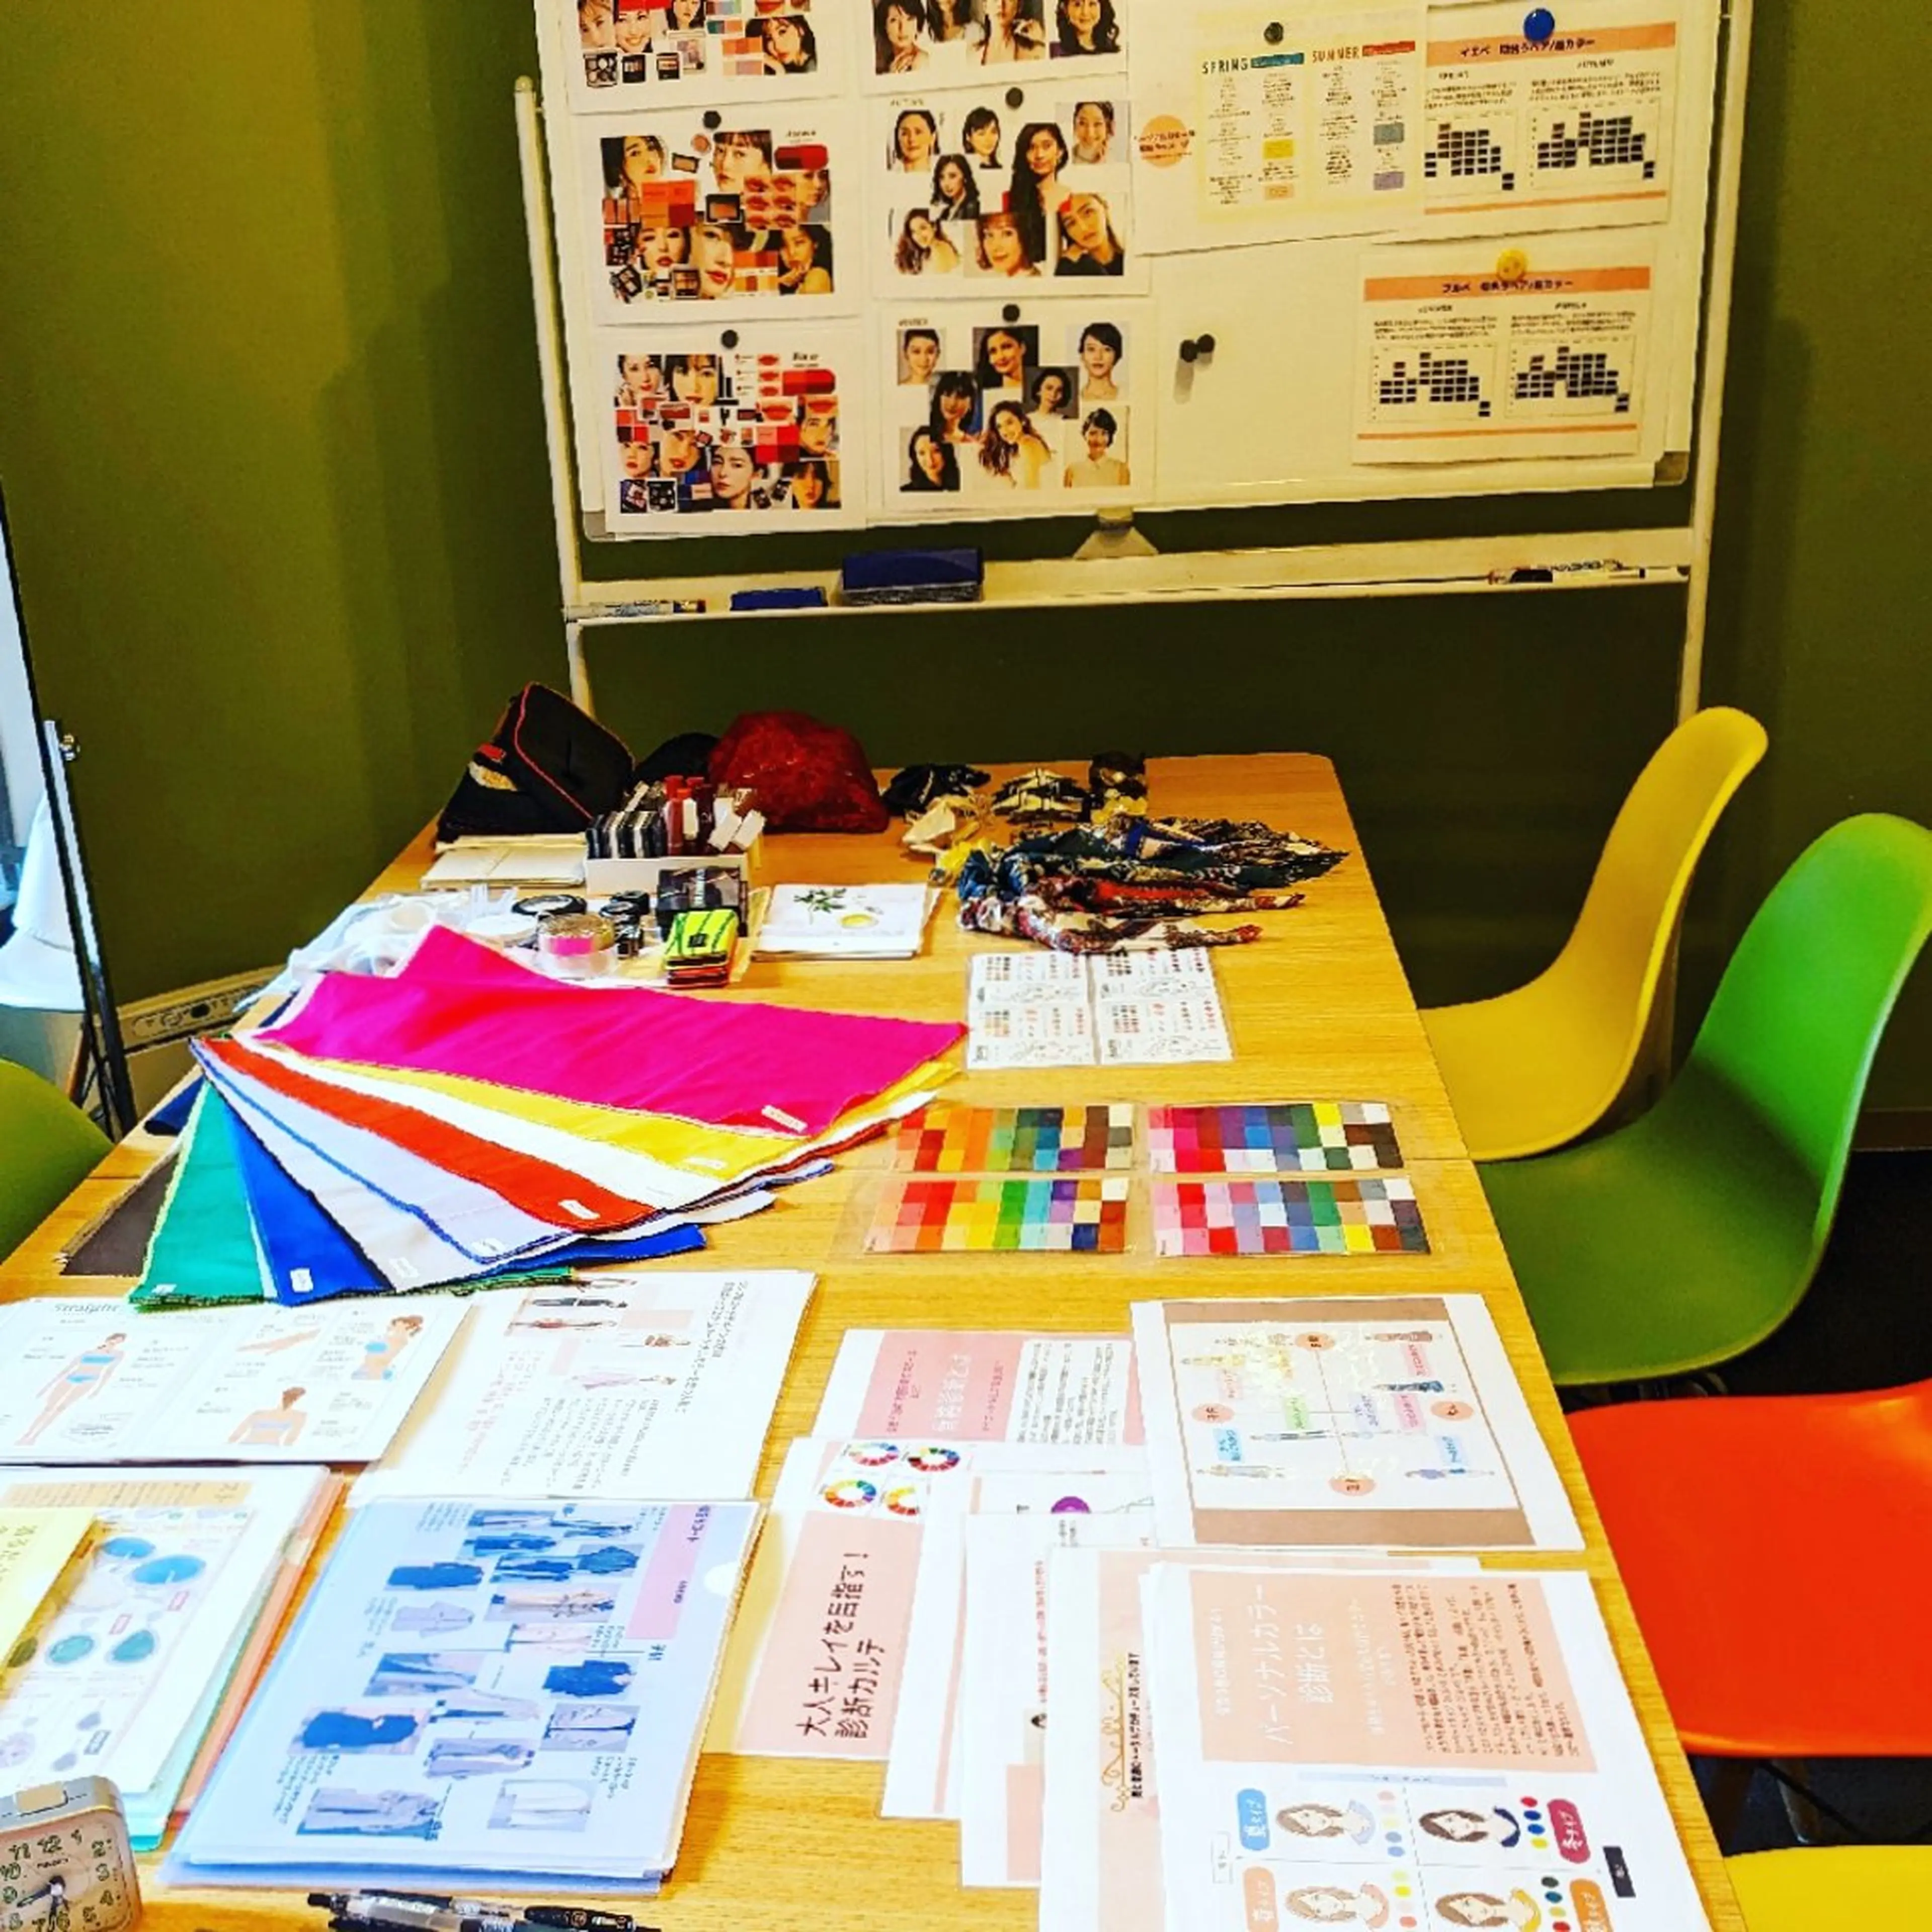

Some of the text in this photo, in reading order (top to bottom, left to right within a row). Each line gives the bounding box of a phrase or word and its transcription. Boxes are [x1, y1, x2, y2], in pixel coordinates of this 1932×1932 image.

[1312, 46, 1360, 63] SUMMER
[1202, 57, 1248, 74] SPRING
[794, 1552, 869, 1738] 大人キレイを目指す！
[1248, 1583, 1294, 1745] パーソナルカラー
[1294, 1621, 1335, 1705] 診断とは
[834, 1638, 887, 1739] 診断カルテ
[1558, 1807, 1584, 1853] 冬タイプ
[37, 1834, 64, 1855] 12
[91, 1839, 106, 1859] 2
[96, 1863, 111, 1882] 3
[3, 1886, 18, 1904] 9
[100, 1889, 114, 1906] 4
[9, 1912, 24, 1931] 8
[83, 1906, 98, 1924] 5
